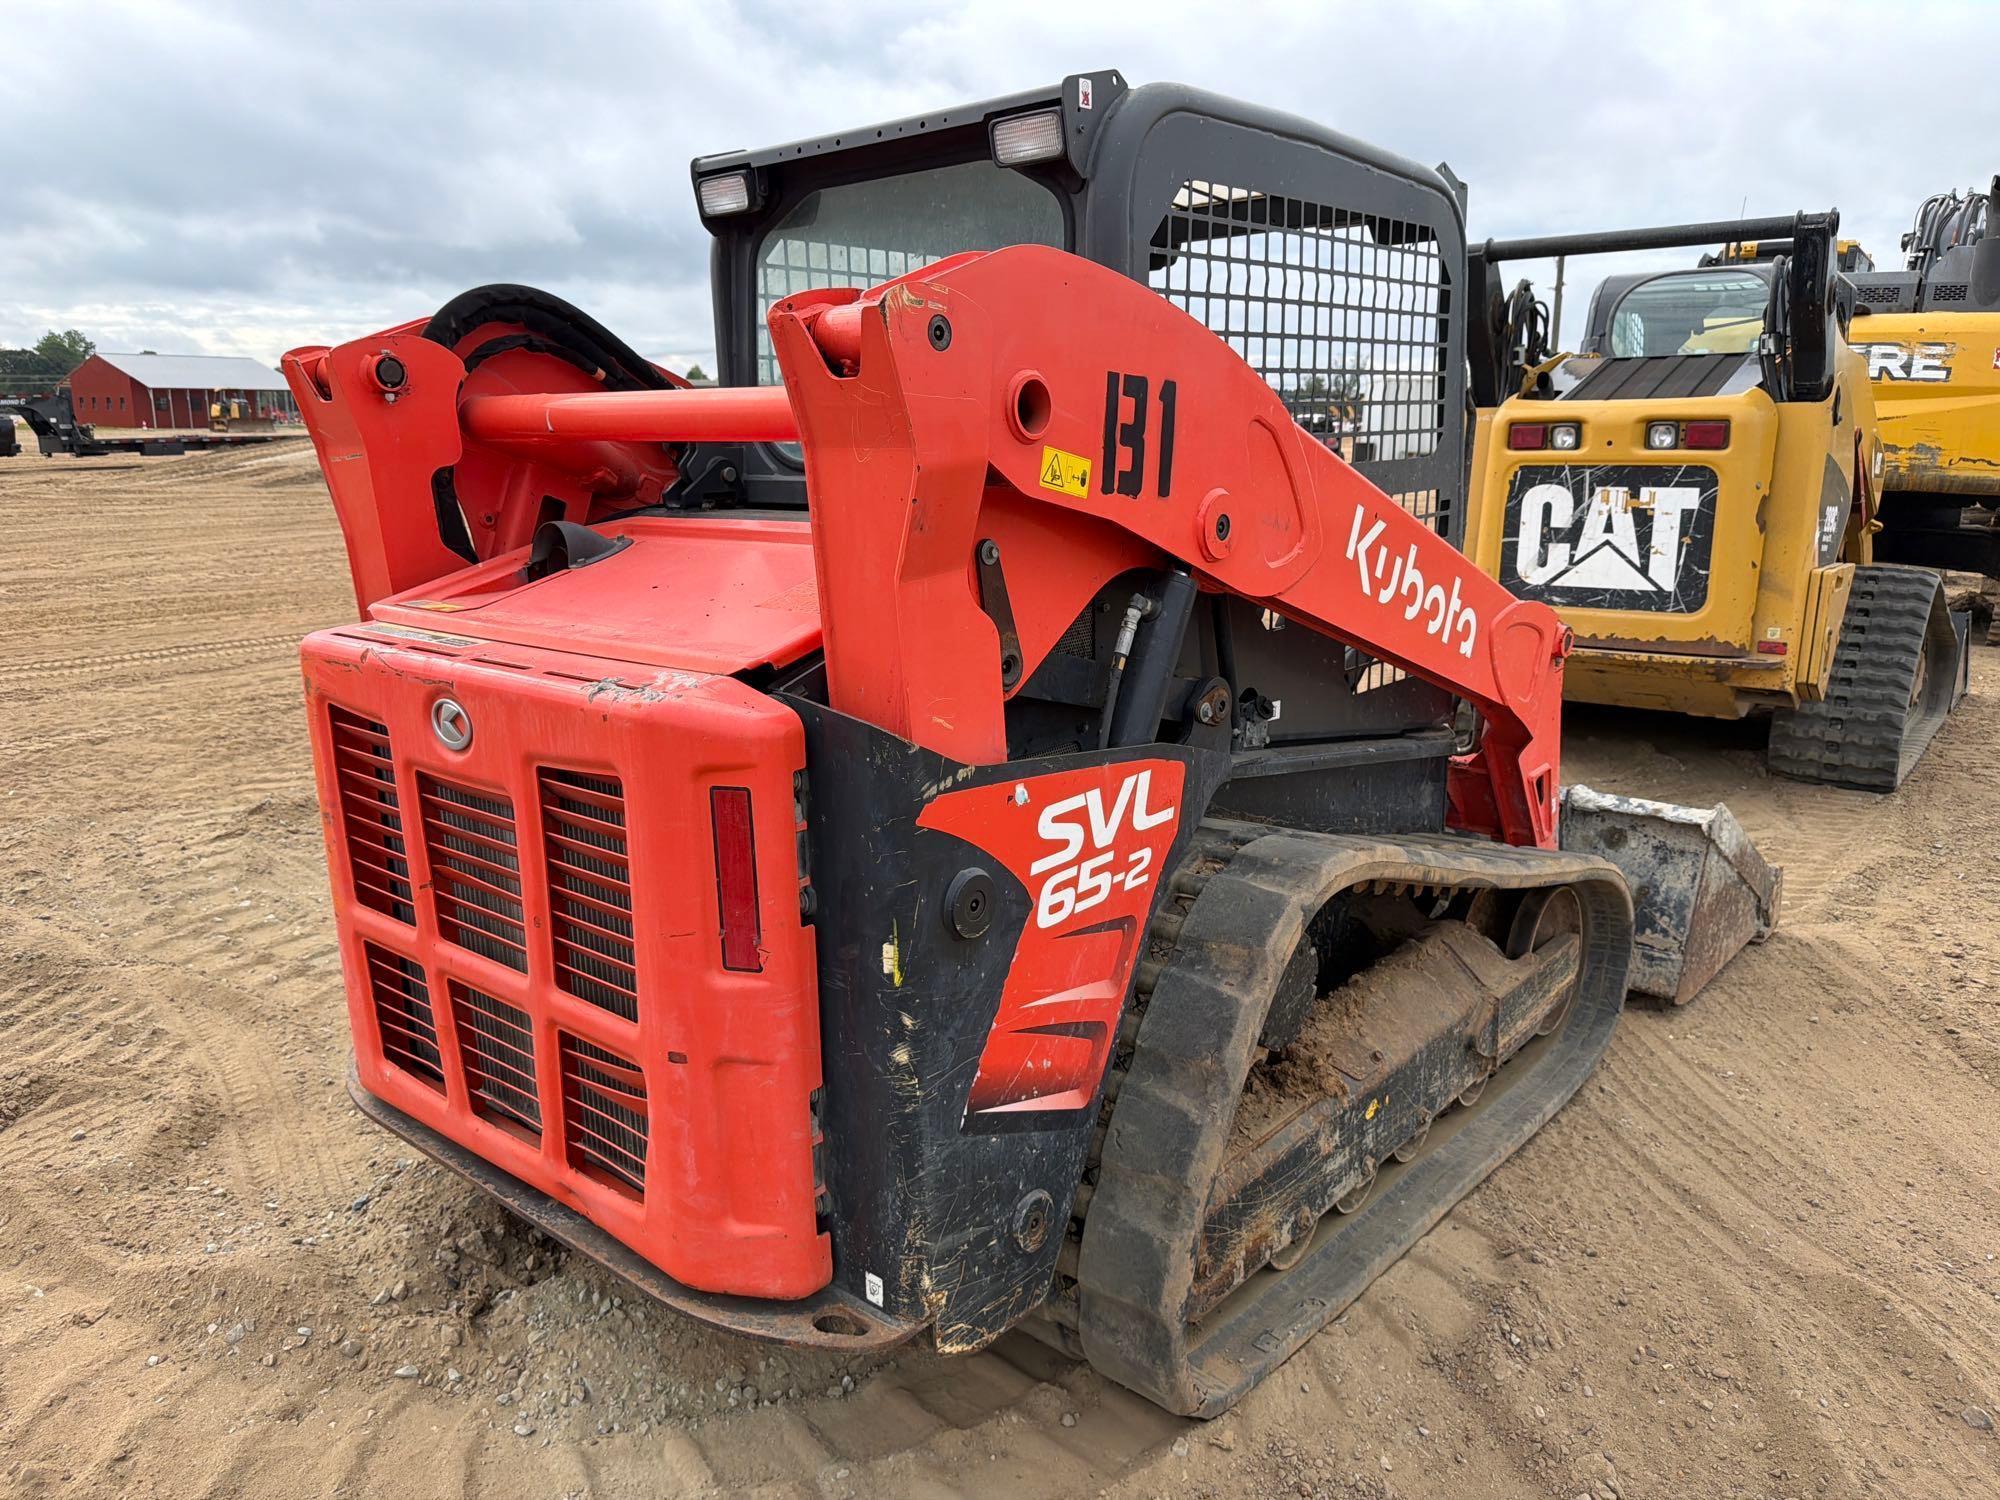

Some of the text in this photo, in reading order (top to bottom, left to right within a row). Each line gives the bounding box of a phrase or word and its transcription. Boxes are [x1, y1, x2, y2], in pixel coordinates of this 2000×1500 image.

[1847, 342, 1955, 381] RE
[1345, 503, 1477, 659] Kubota
[1516, 483, 1700, 592] CAT
[1030, 769, 1175, 877] SVL
[1036, 846, 1152, 929] 65-2
